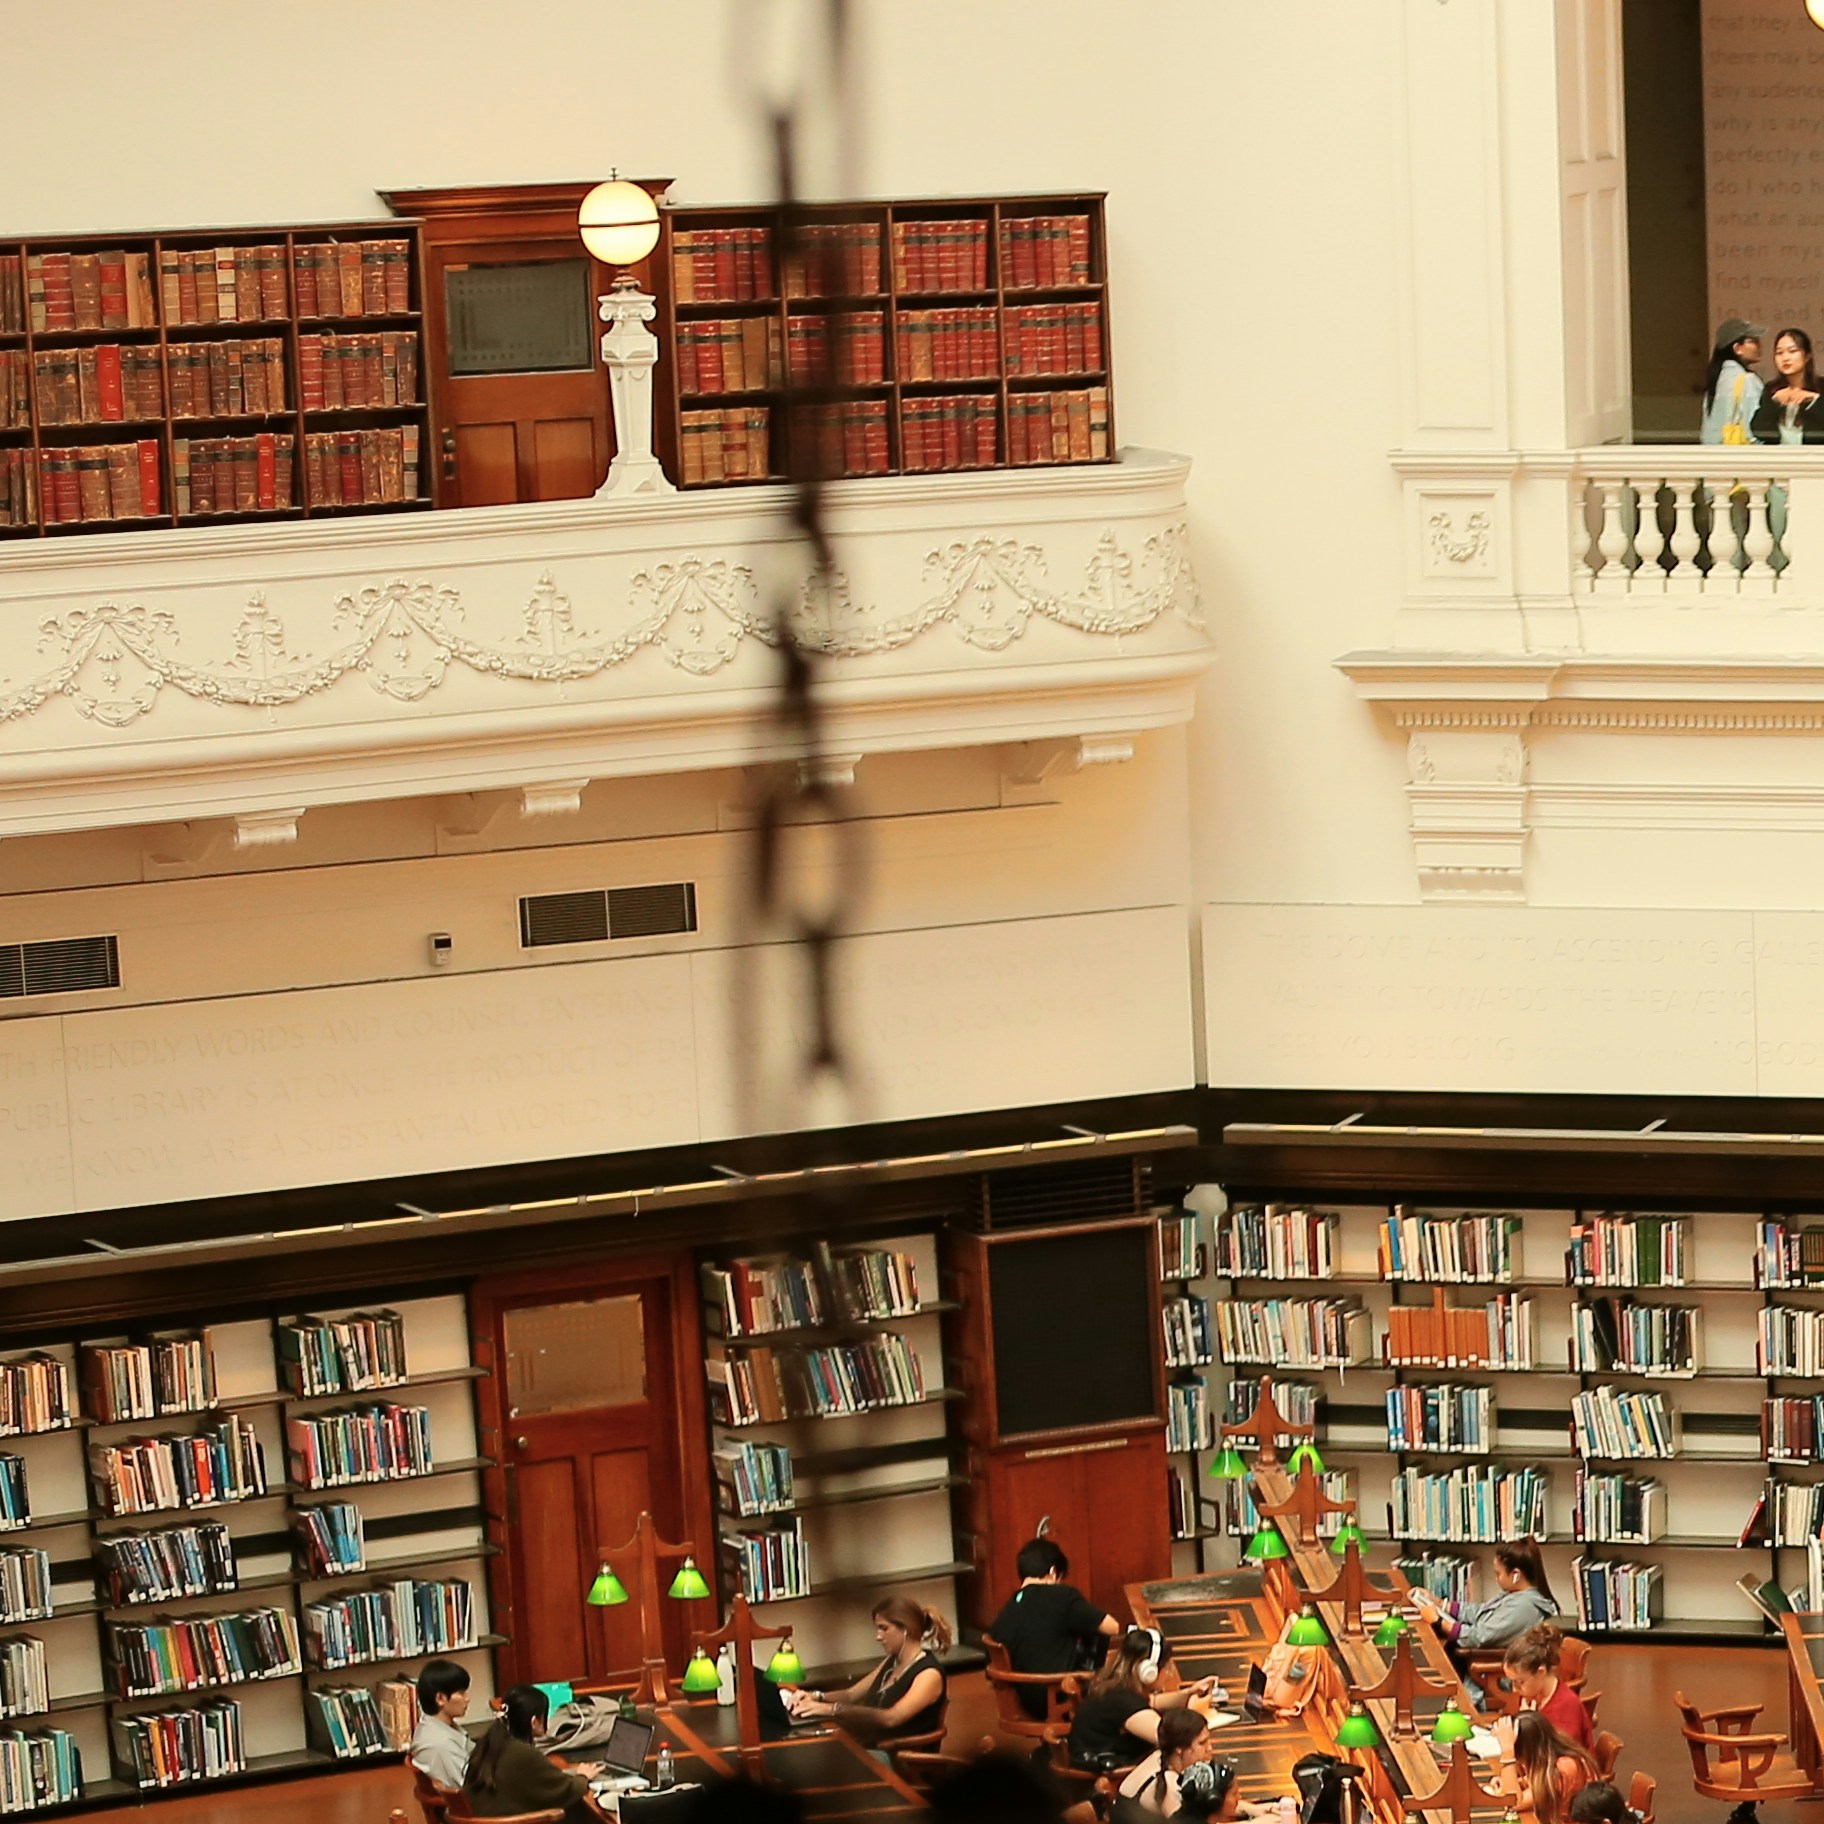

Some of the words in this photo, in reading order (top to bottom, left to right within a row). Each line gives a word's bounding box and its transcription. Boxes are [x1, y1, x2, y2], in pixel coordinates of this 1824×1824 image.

[1712, 115, 1753, 135] why
[1712, 145, 1800, 168] perfectly
[1713, 177, 1739, 195] do
[1760, 177, 1803, 195] who
[1713, 209, 1760, 227] what
[1767, 213, 1790, 227] an
[1715, 240, 1770, 258] been
